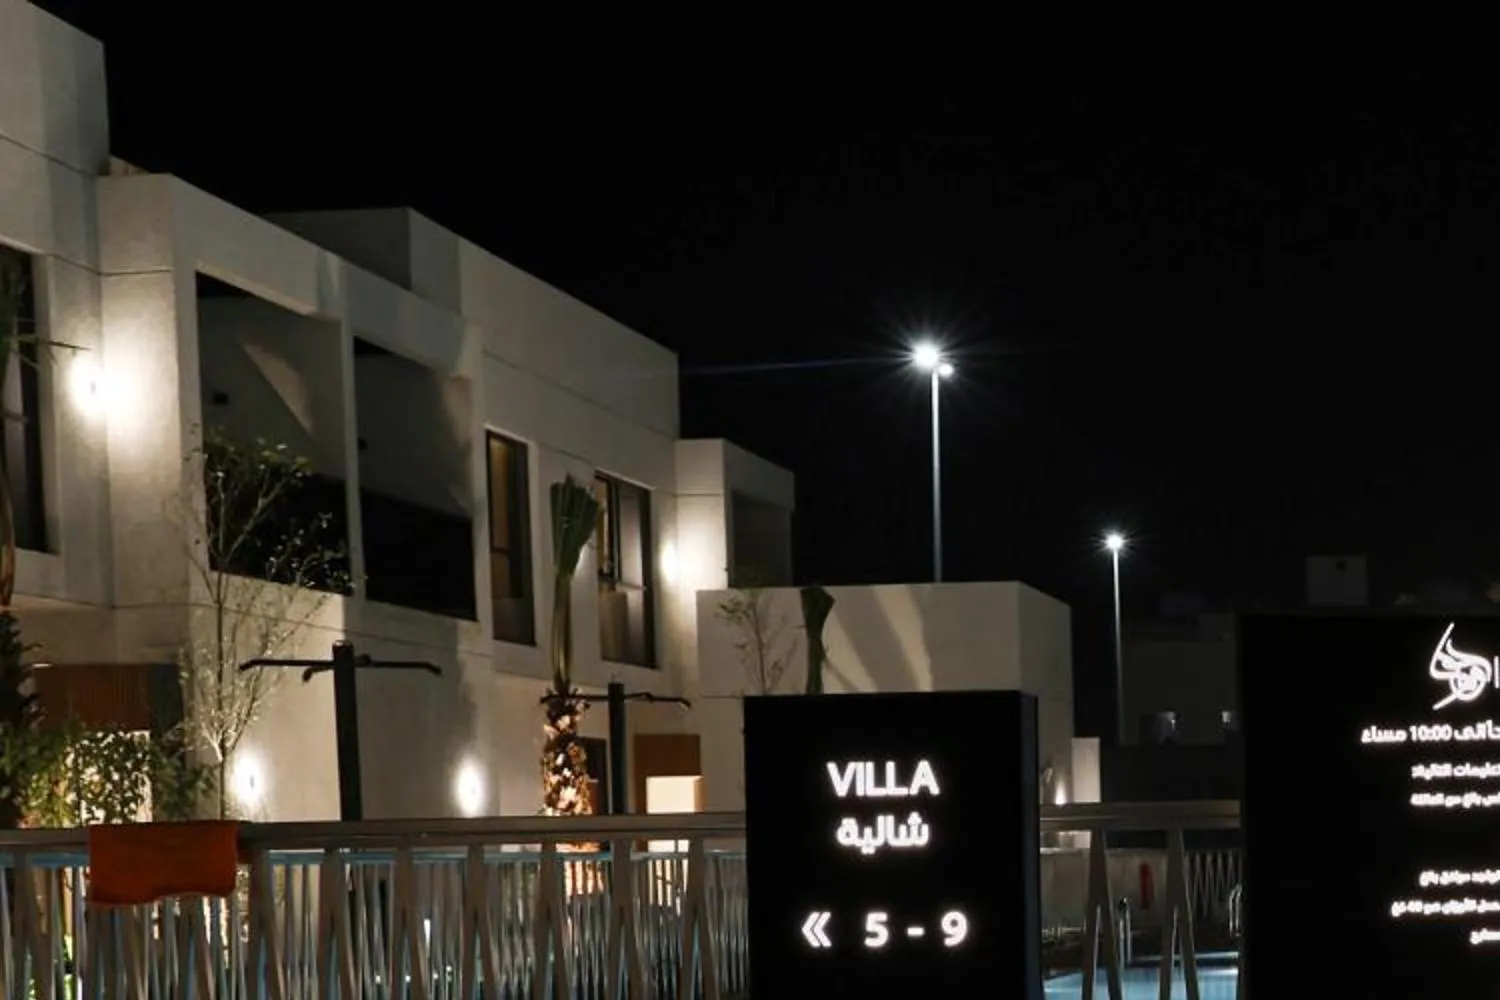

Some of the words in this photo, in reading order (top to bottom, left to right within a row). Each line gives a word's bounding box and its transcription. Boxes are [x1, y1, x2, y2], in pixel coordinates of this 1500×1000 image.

[1410, 724, 1452, 741] 10:00
[826, 760, 940, 797] VILLA
[836, 812, 930, 854] شاليه
[864, 911, 889, 947] 5
[941, 911, 968, 947] 9
